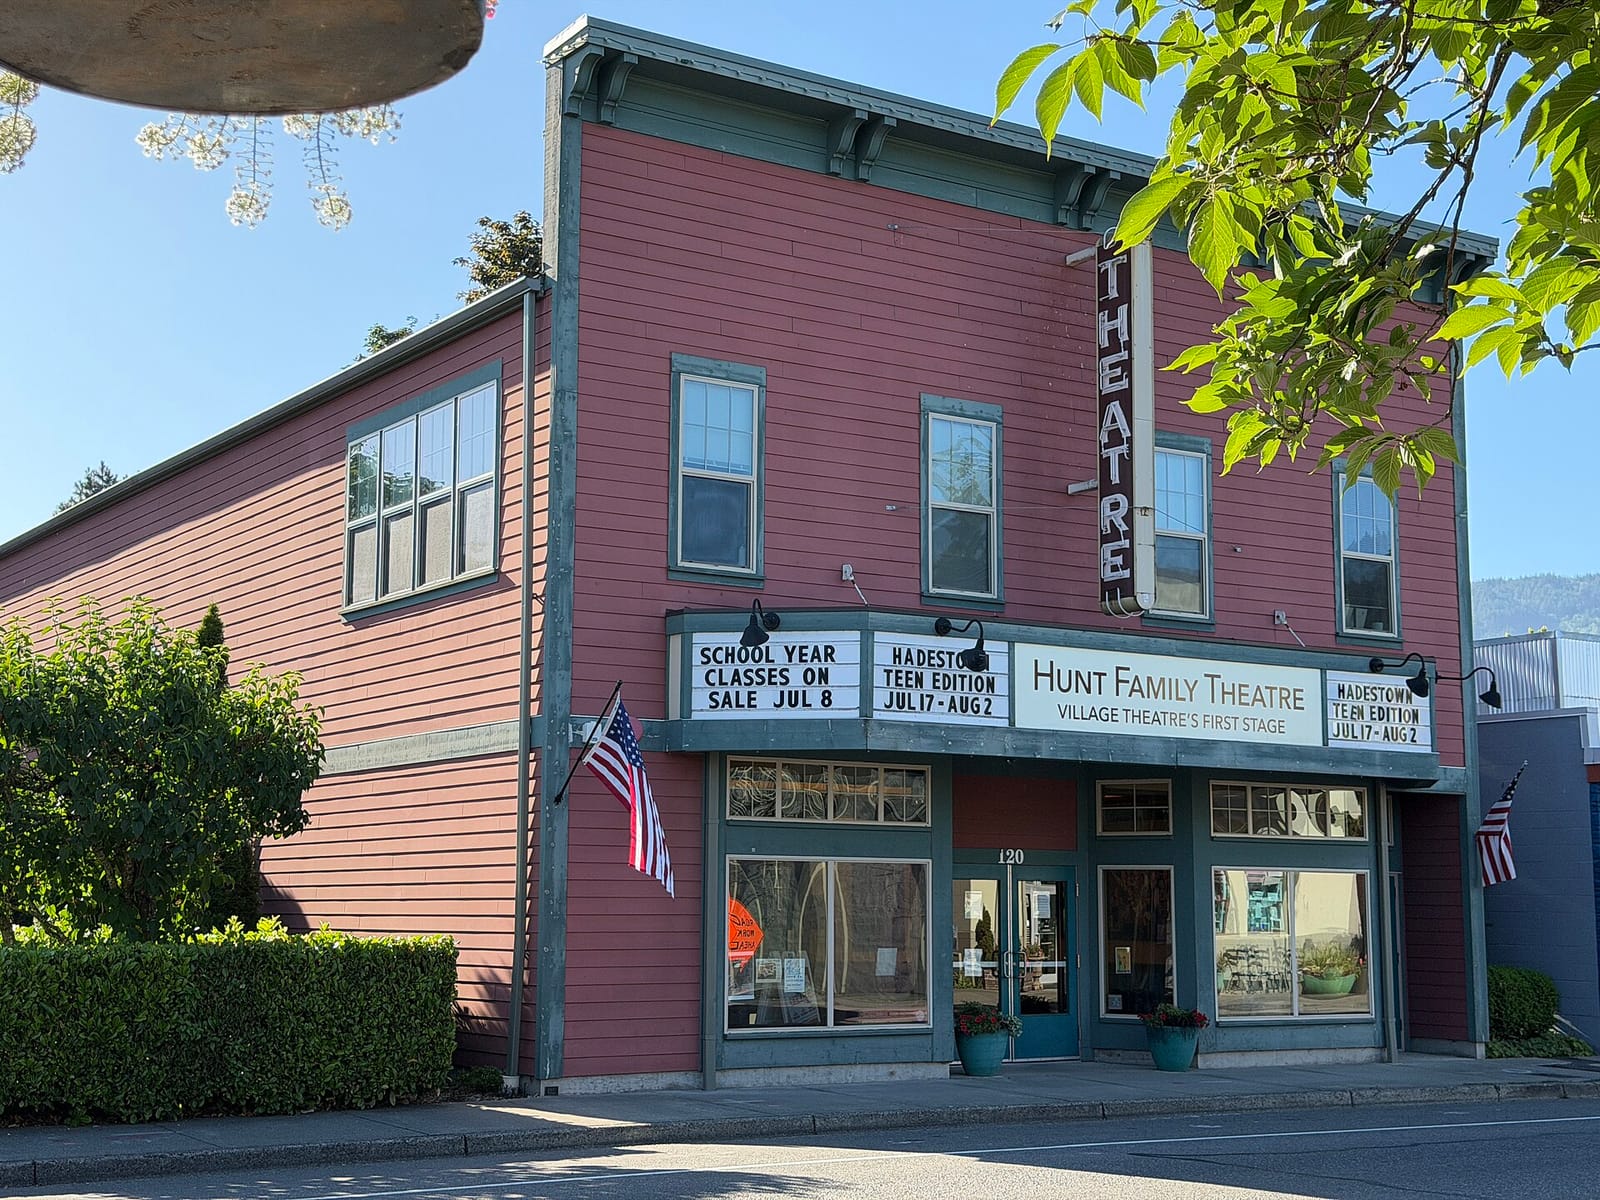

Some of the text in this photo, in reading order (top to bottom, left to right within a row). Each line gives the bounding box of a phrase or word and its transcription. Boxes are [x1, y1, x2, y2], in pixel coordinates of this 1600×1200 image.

[1098, 254, 1131, 580] THEATRE
[700, 645, 836, 665] SCHOOL YEAR
[892, 646, 990, 672] HADESTO
[704, 667, 829, 686] CLASSES ON
[883, 669, 995, 694] TEEN EDITION
[708, 689, 833, 709] SALE JUL 8
[1337, 683, 1413, 705] HADESTOWN
[1057, 703, 1286, 734] VILLAGE THEATRE'S FIRST STAGE
[1332, 702, 1419, 725] TEEN EDITION
[998, 848, 1024, 865] 120
